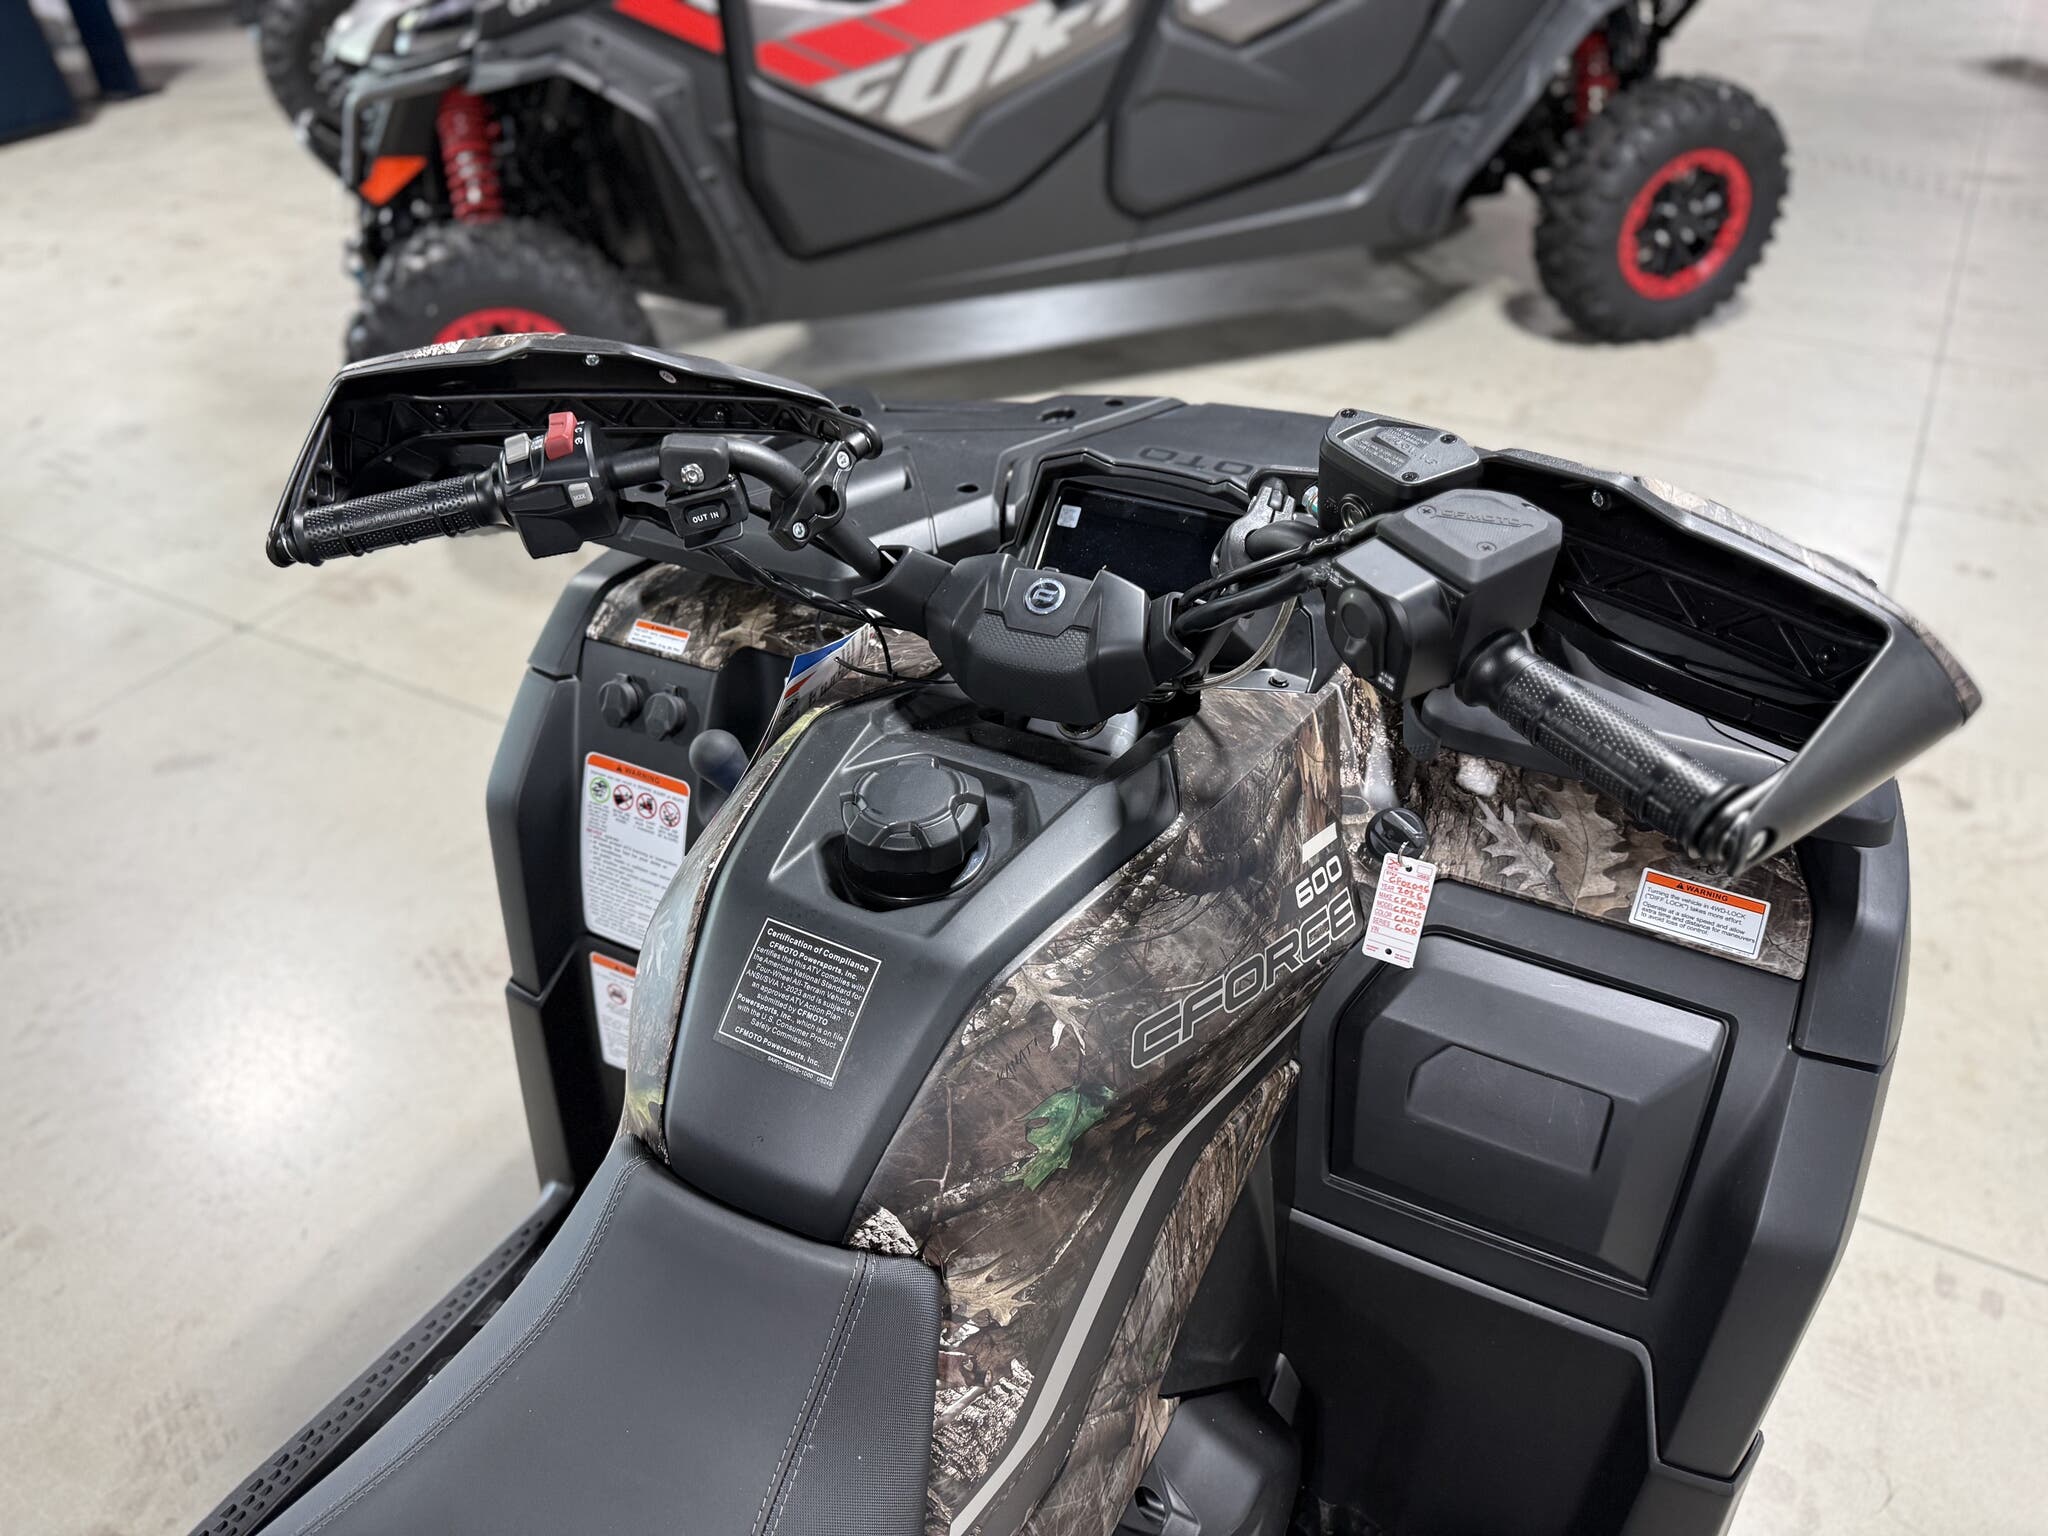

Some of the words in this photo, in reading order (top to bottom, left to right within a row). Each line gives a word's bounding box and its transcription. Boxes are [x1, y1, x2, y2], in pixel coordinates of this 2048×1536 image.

[692, 513, 707, 523] OUT
[1440, 509, 1520, 525] CFMOTO
[625, 767, 660, 784] WARNING
[1295, 855, 1342, 909] 600
[1396, 886, 1423, 900] 2026
[1686, 885, 1728, 901] WARNING
[1375, 908, 1392, 917] COLOR
[1642, 901, 1666, 912] Operate
[1696, 917, 1714, 926] speed
[1646, 887, 1668, 897] Turning
[1681, 897, 1701, 906] vehicle
[1710, 905, 1745, 919] 4WD-LOCK
[1685, 919, 1710, 930] distance
[1720, 930, 1754, 943] maneuvers
[756, 945, 781, 959] certifies
[781, 955, 794, 964] that
[794, 960, 806, 969] this
[806, 965, 820, 974] ATV
[820, 970, 850, 987] complies
[851, 982, 865, 992] with
[766, 928, 813, 950] Certification
[814, 946, 822, 954] of
[822, 949, 869, 973] Compliance
[769, 941, 798, 956] CFMOTO
[798, 952, 844, 975] Powersports,
[844, 970, 858, 980] Inc.
[746, 969, 779, 986] ANSI/SVIA
[780, 983, 802, 995] 1-2023
[802, 992, 814, 1000] and
[822, 1000, 847, 1015] subject
[753, 953, 763, 961] the
[763, 957, 792, 973] American
[793, 969, 820, 984] National
[820, 980, 850, 996] Standard
[851, 992, 861, 1000] for
[755, 964, 792, 982] Four-Wheel
[792, 978, 825, 995] All-Terrain
[826, 992, 850, 1005] Vehicle
[1131, 887, 1356, 1069] CFORCE
[736, 993, 779, 1016] Powersports,
[780, 1011, 796, 1023] Inc.,
[796, 1017, 815, 1030] which
[832, 1032, 843, 1041] file
[757, 992, 787, 1009] submitted
[796, 1008, 828, 1025] CFMOTO
[759, 984, 789, 1001] approved
[790, 996, 803, 1005] ATV
[804, 1002, 825, 1014] Action
[825, 1010, 841, 1020] Plan
[736, 1003, 749, 1012] with
[750, 1009, 760, 1017] the
[760, 1013, 775, 1023] U.S.
[775, 1019, 809, 1037] Consumer
[809, 1033, 836, 1048] Product
[750, 1018, 770, 1032] Safety
[771, 1027, 813, 1048] Commission.
[734, 1026, 762, 1042] CFMOTO
[762, 1038, 806, 1061] Powersports,
[806, 1056, 821, 1067] Inc.
